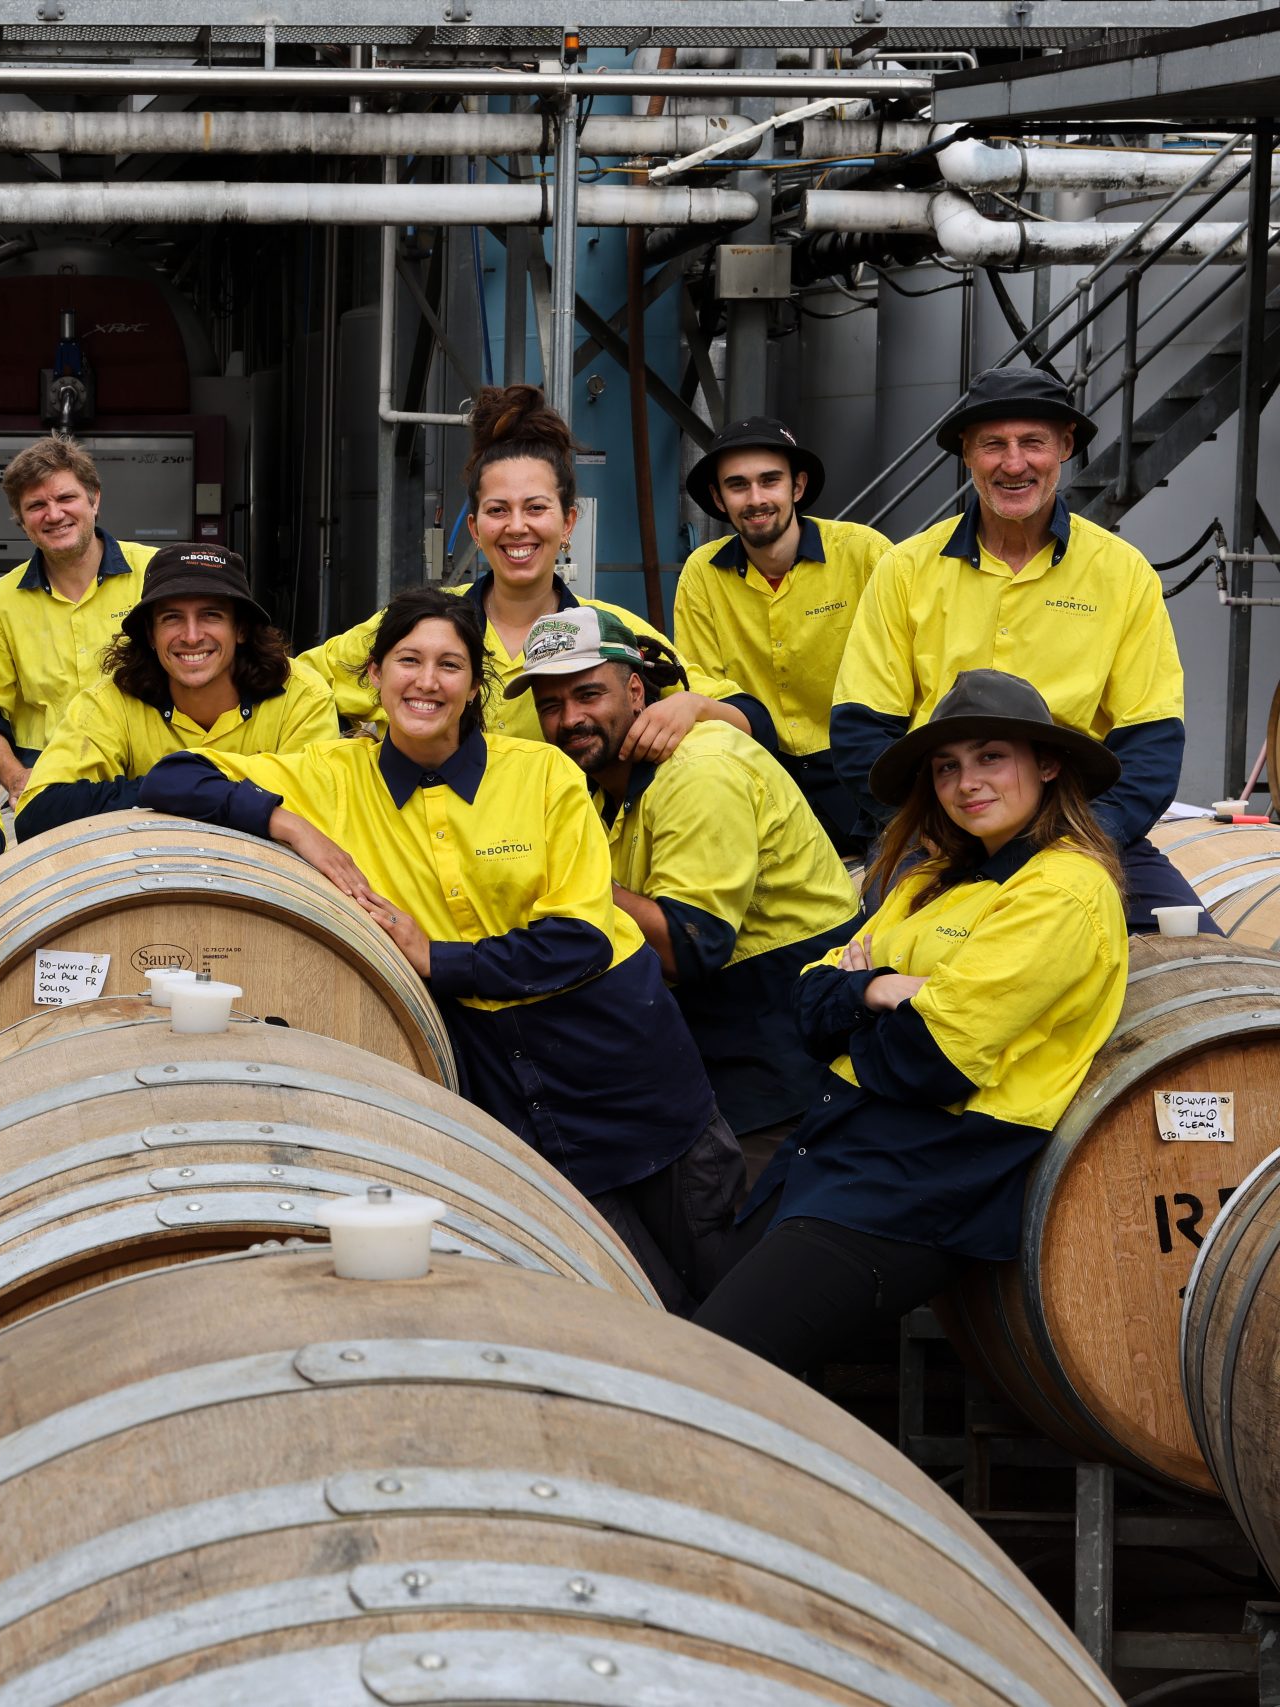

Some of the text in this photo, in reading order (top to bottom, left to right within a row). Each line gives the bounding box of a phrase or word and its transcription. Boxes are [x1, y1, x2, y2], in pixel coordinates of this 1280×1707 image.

[1055, 600, 1097, 612] BORTOLI
[487, 843, 532, 856] BORTOLI
[138, 950, 186, 968] Saury
[1179, 1121, 1214, 1129] CLEAN
